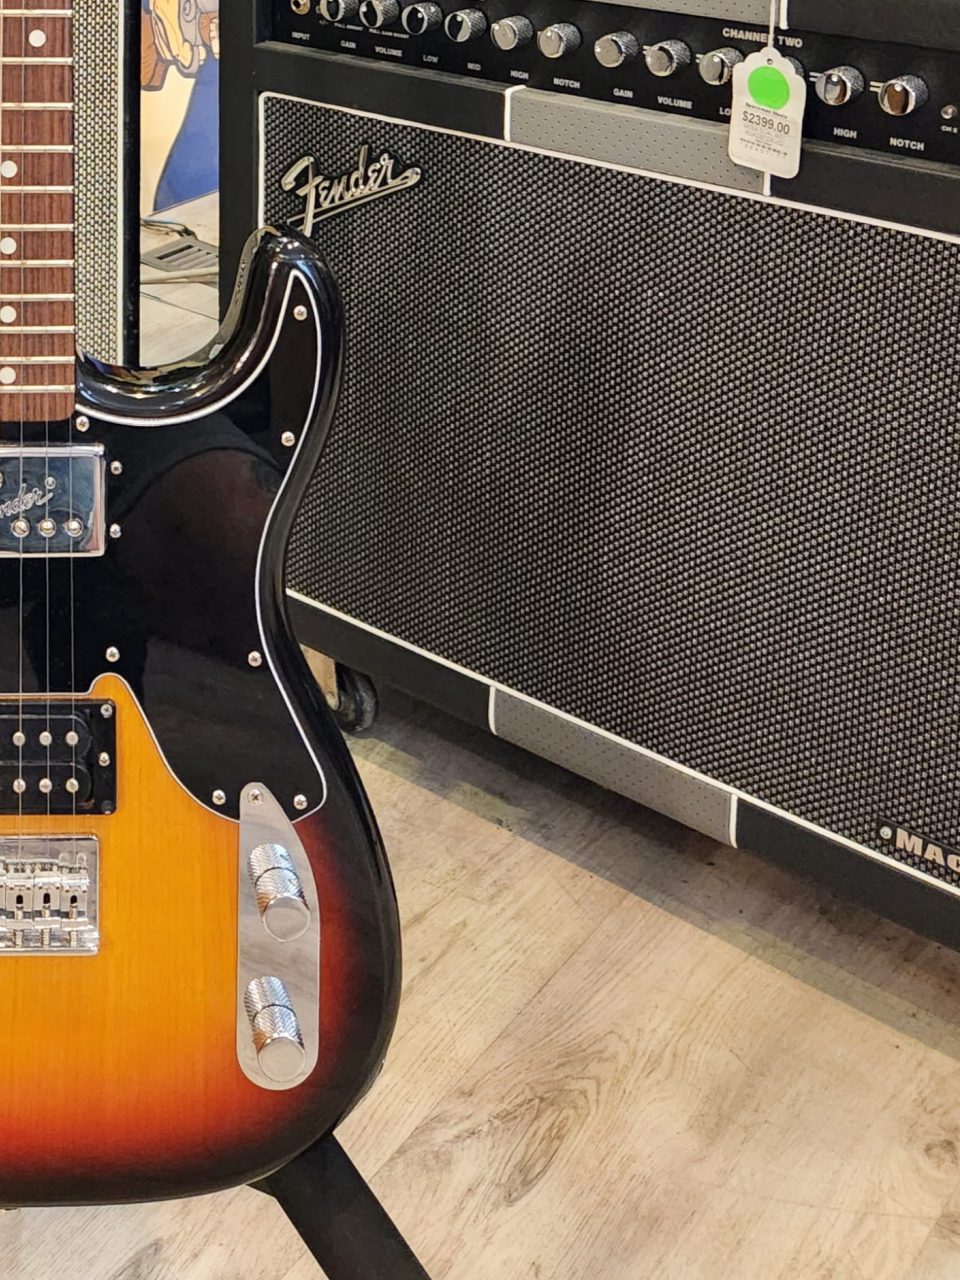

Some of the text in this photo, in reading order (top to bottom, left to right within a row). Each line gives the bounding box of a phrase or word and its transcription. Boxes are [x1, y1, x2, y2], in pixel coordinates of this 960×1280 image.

[291, 31, 310, 41] INPUT
[722, 27, 803, 48] CHANNE TWO
[340, 40, 356, 49] GAIN
[375, 46, 403, 57] VOLUME
[423, 54, 439, 64] LOW
[467, 62, 481, 71] MID
[510, 70, 529, 80] HIGH
[553, 77, 581, 89] NOTCH
[613, 87, 633, 98] GAIN
[657, 95, 693, 109] VOLUME
[719, 107, 732, 116] LO
[742, 110, 790, 135] $2399.00
[833, 127, 858, 139] HIGH
[889, 137, 925, 151] NOTCH
[281, 144, 422, 238] Fender
